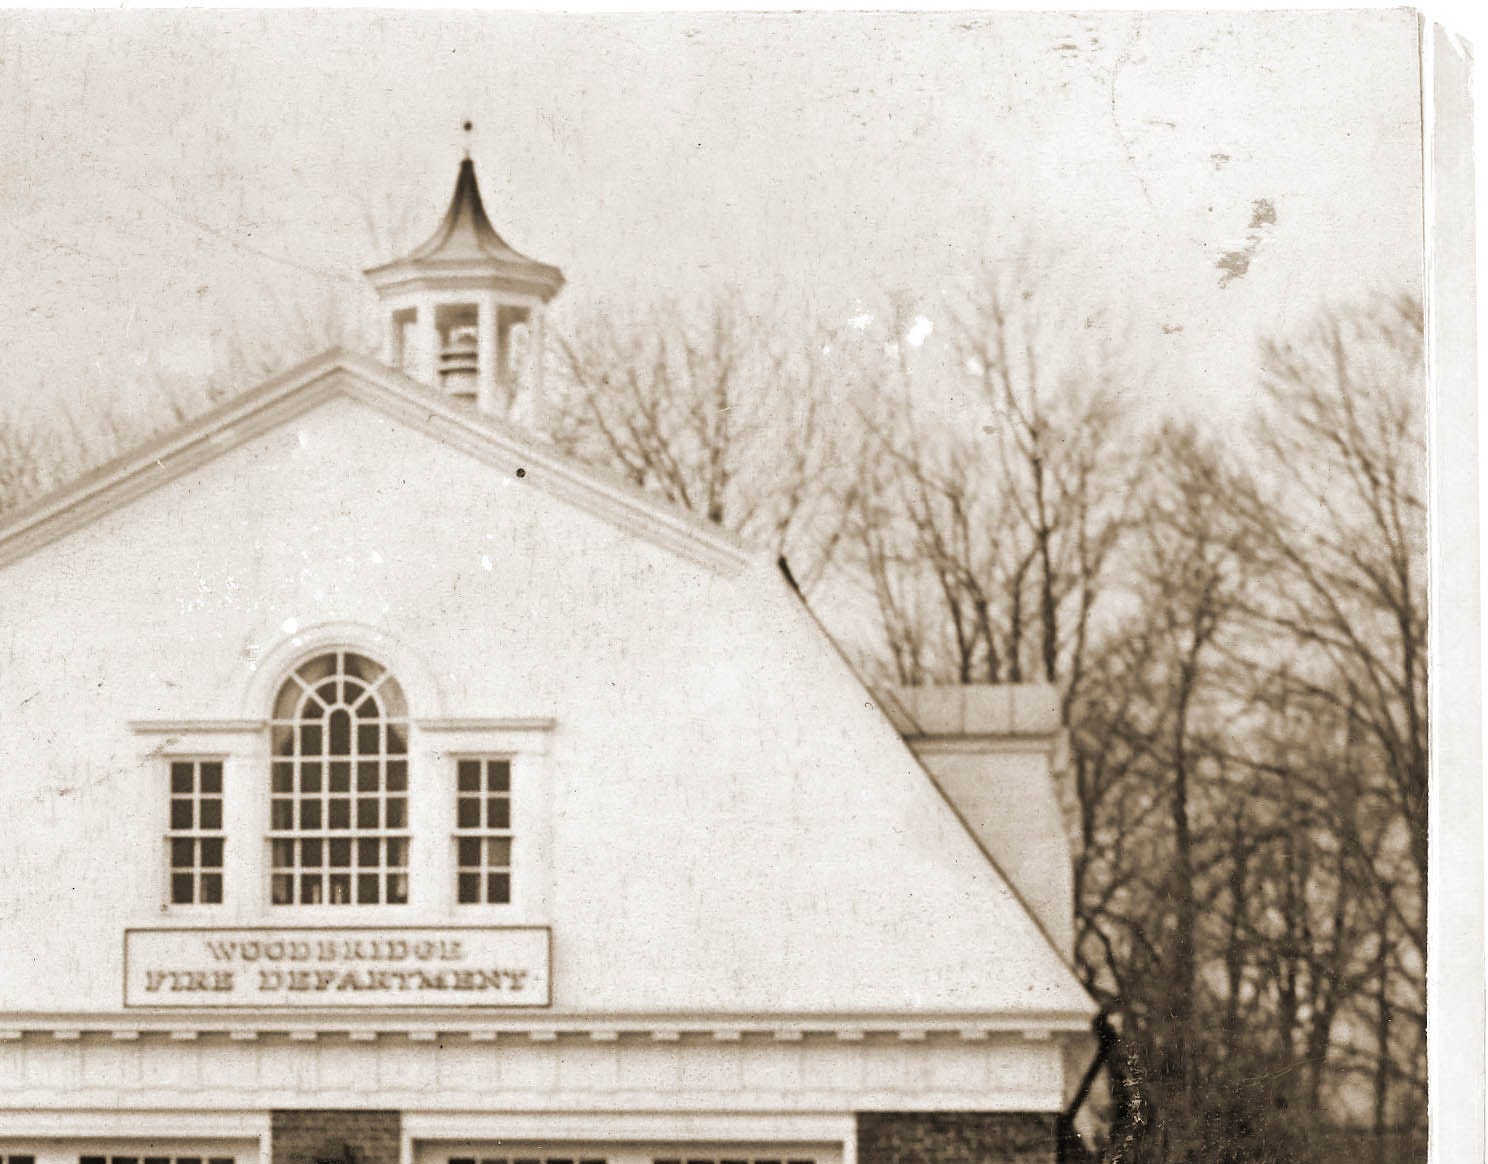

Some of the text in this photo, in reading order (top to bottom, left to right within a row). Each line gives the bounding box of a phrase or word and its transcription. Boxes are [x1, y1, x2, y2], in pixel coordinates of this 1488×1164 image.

[207, 939, 465, 962] WOODBRIDGE
[145, 968, 528, 992] FIRE DEPARTMENT
